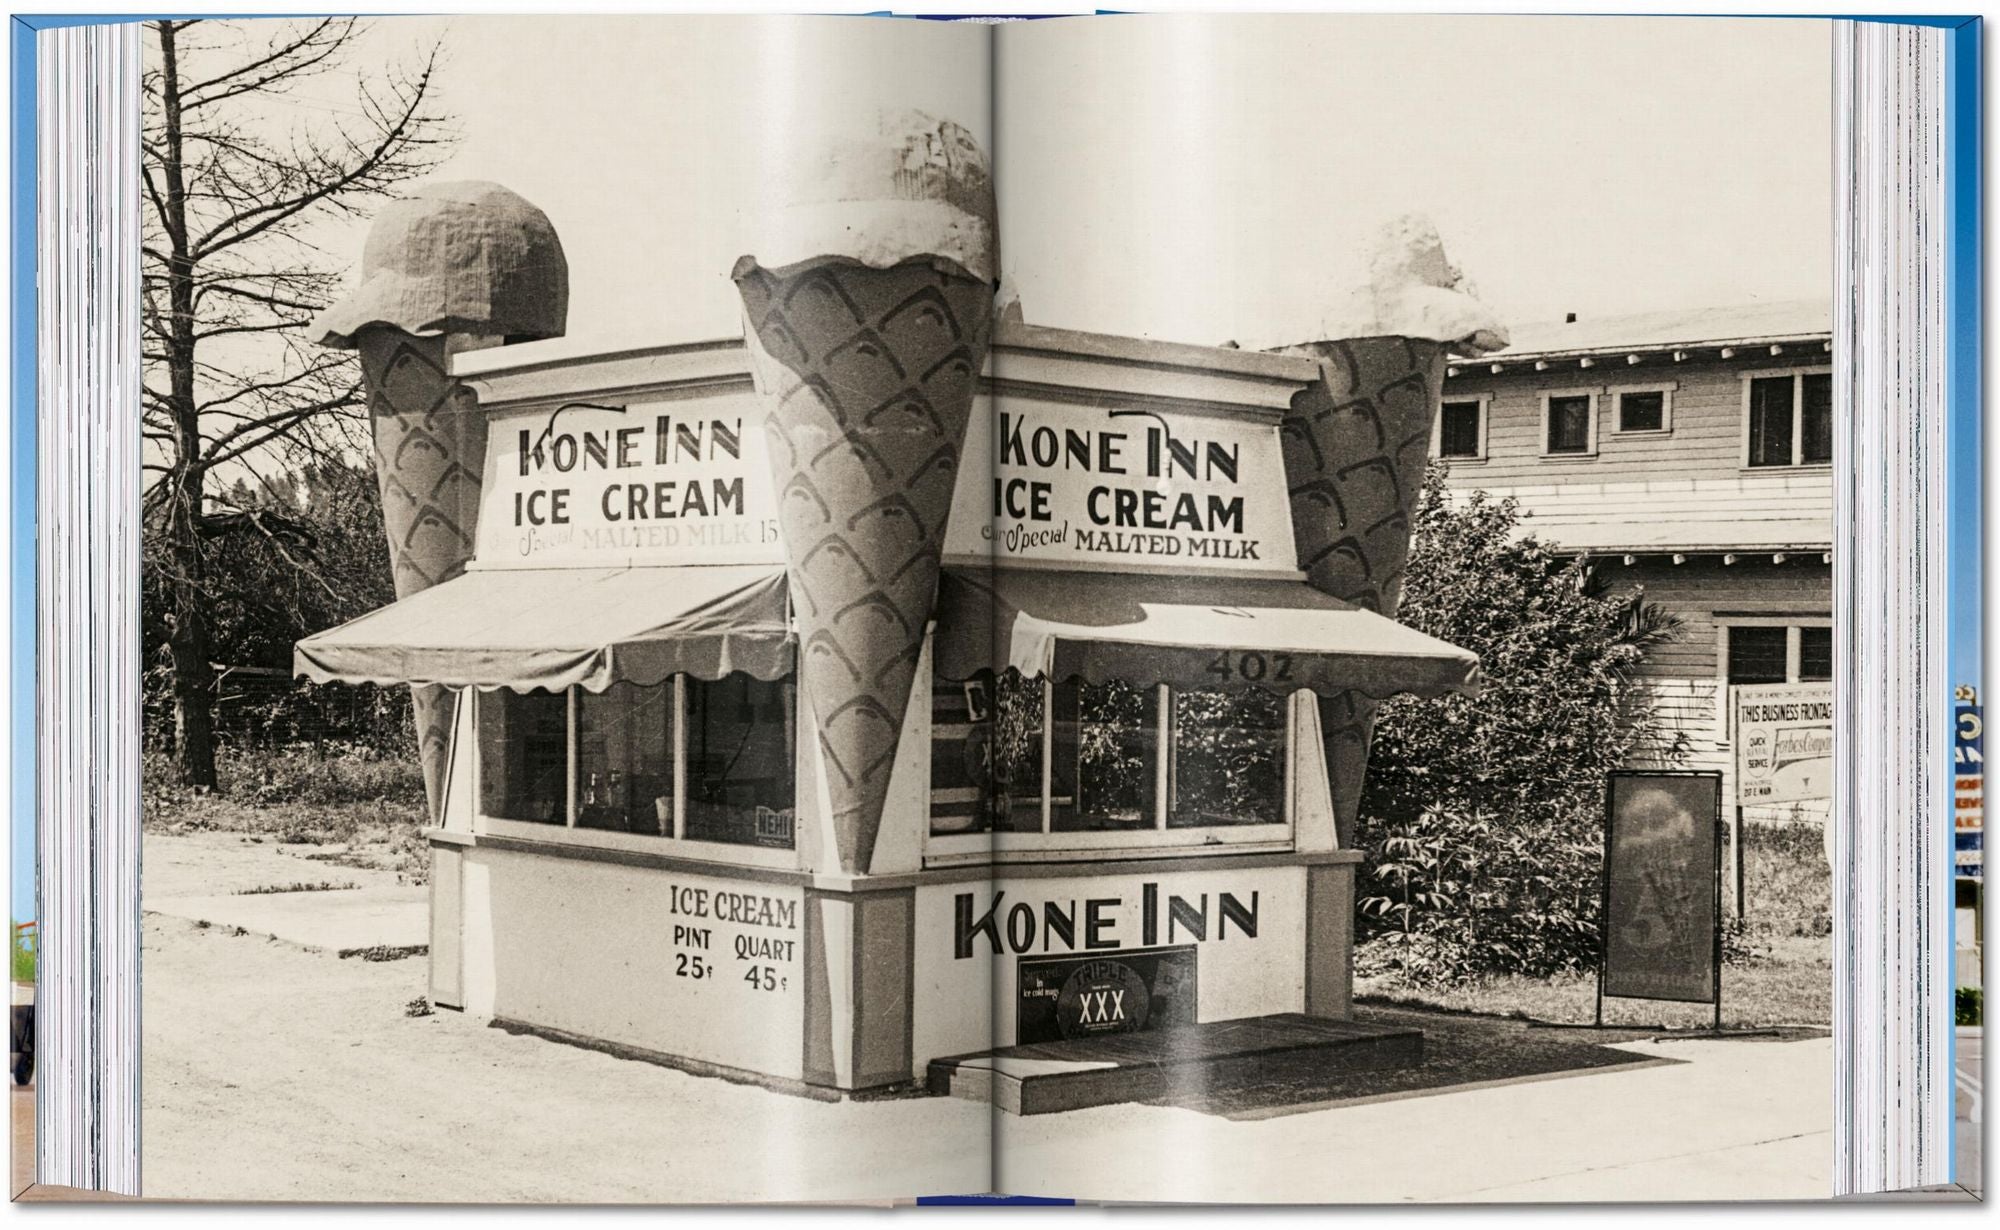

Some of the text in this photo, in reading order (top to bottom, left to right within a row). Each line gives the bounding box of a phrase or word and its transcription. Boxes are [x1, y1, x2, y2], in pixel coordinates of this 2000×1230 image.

[519, 415, 742, 476] KONE INN
[999, 411, 1239, 483] KONE INN
[514, 477, 744, 526] ICE CREAM
[994, 477, 1244, 534] ICE CREAM
[582, 524, 681, 550] MALTED
[687, 522, 752, 548] MILK
[1006, 520, 1067, 553] Special
[1075, 529, 1181, 557] MALTED
[1187, 537, 1261, 560] MILK
[1206, 651, 1293, 681] 402
[1741, 705, 1760, 723] THIS
[1762, 703, 1799, 722] BUSINESS
[757, 812, 789, 837] NEHI
[670, 885, 797, 929] ICE CREAM
[954, 882, 1259, 960] KONE INN
[674, 925, 795, 962] PINT QUART
[1073, 963, 1127, 986] TRIPLE
[1079, 989, 1125, 1024] XXX
